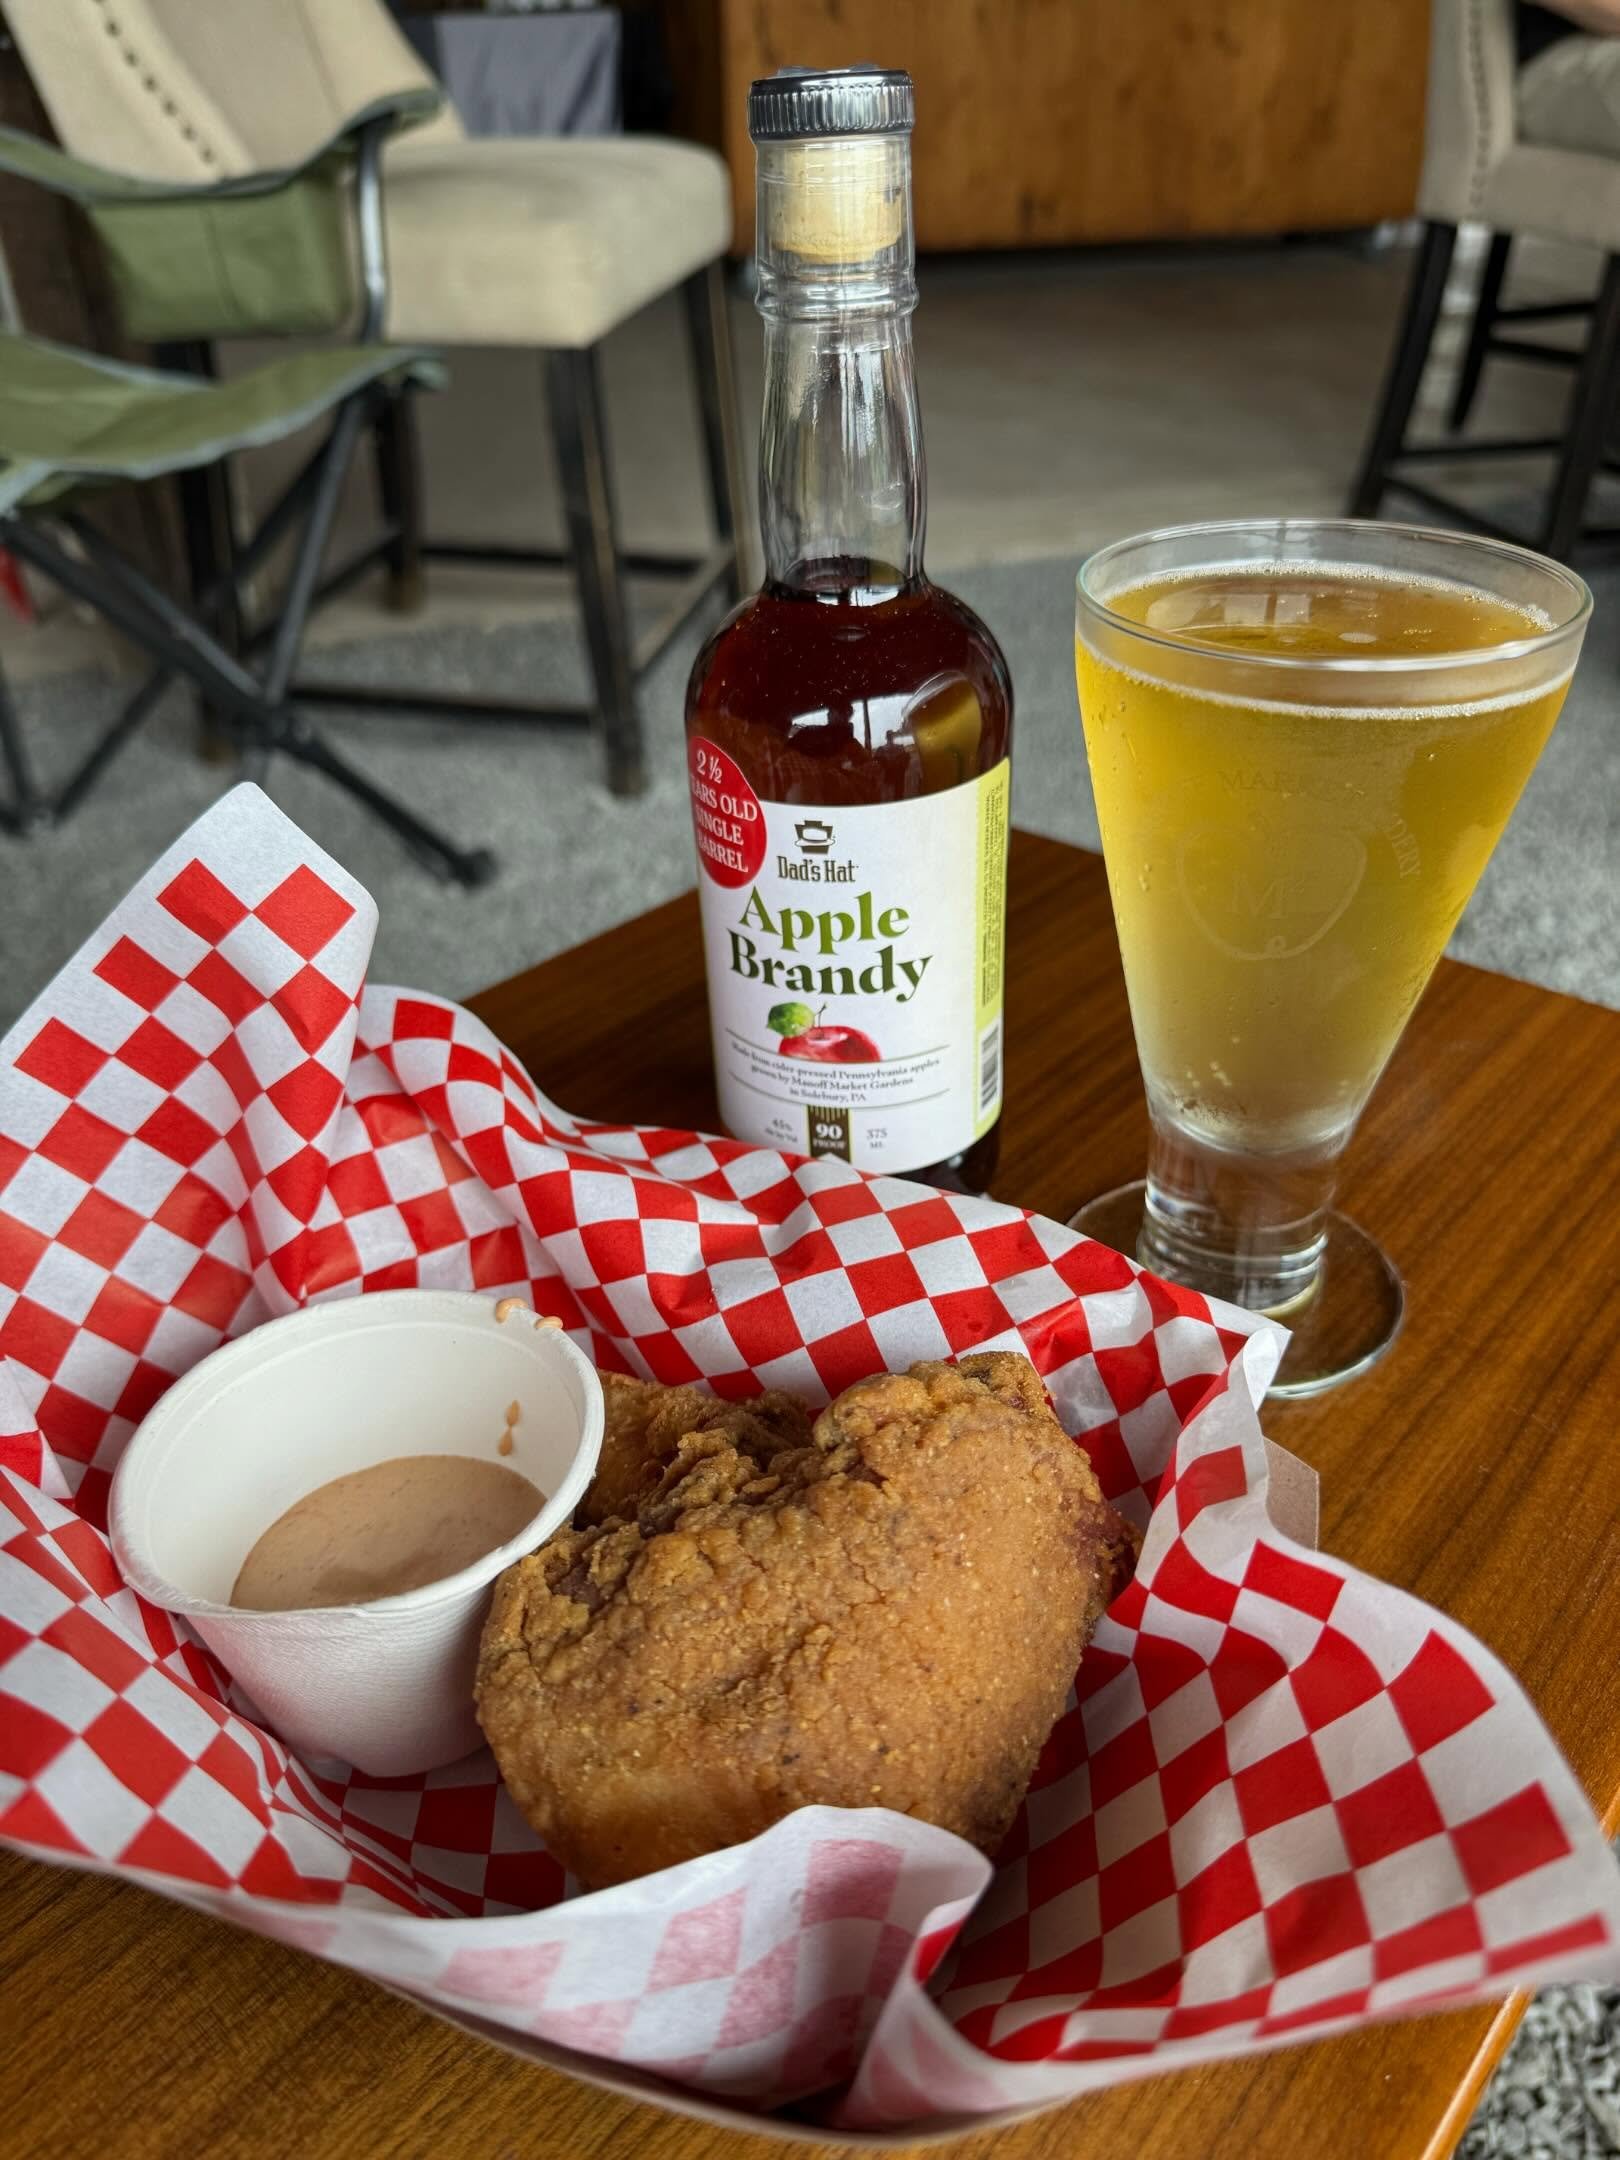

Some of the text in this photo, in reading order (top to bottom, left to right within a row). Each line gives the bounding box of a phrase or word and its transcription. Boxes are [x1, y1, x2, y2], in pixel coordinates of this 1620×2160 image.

[696, 750, 706, 776] 2
[720, 794, 758, 822] OLD
[823, 859, 856, 883] Hat
[738, 885, 910, 956] Apple
[726, 928, 934, 1003] Brandy
[839, 1066, 908, 1080] Pennsylvania
[910, 1059, 940, 1073] apples
[778, 1071, 790, 1086] by
[791, 1076, 828, 1090] Manoff
[829, 1080, 867, 1091] Market
[870, 1077, 914, 1090] Gardens
[851, 1092, 867, 1102] PA
[815, 1122, 843, 1140] 90
[866, 1127, 888, 1140] 375
